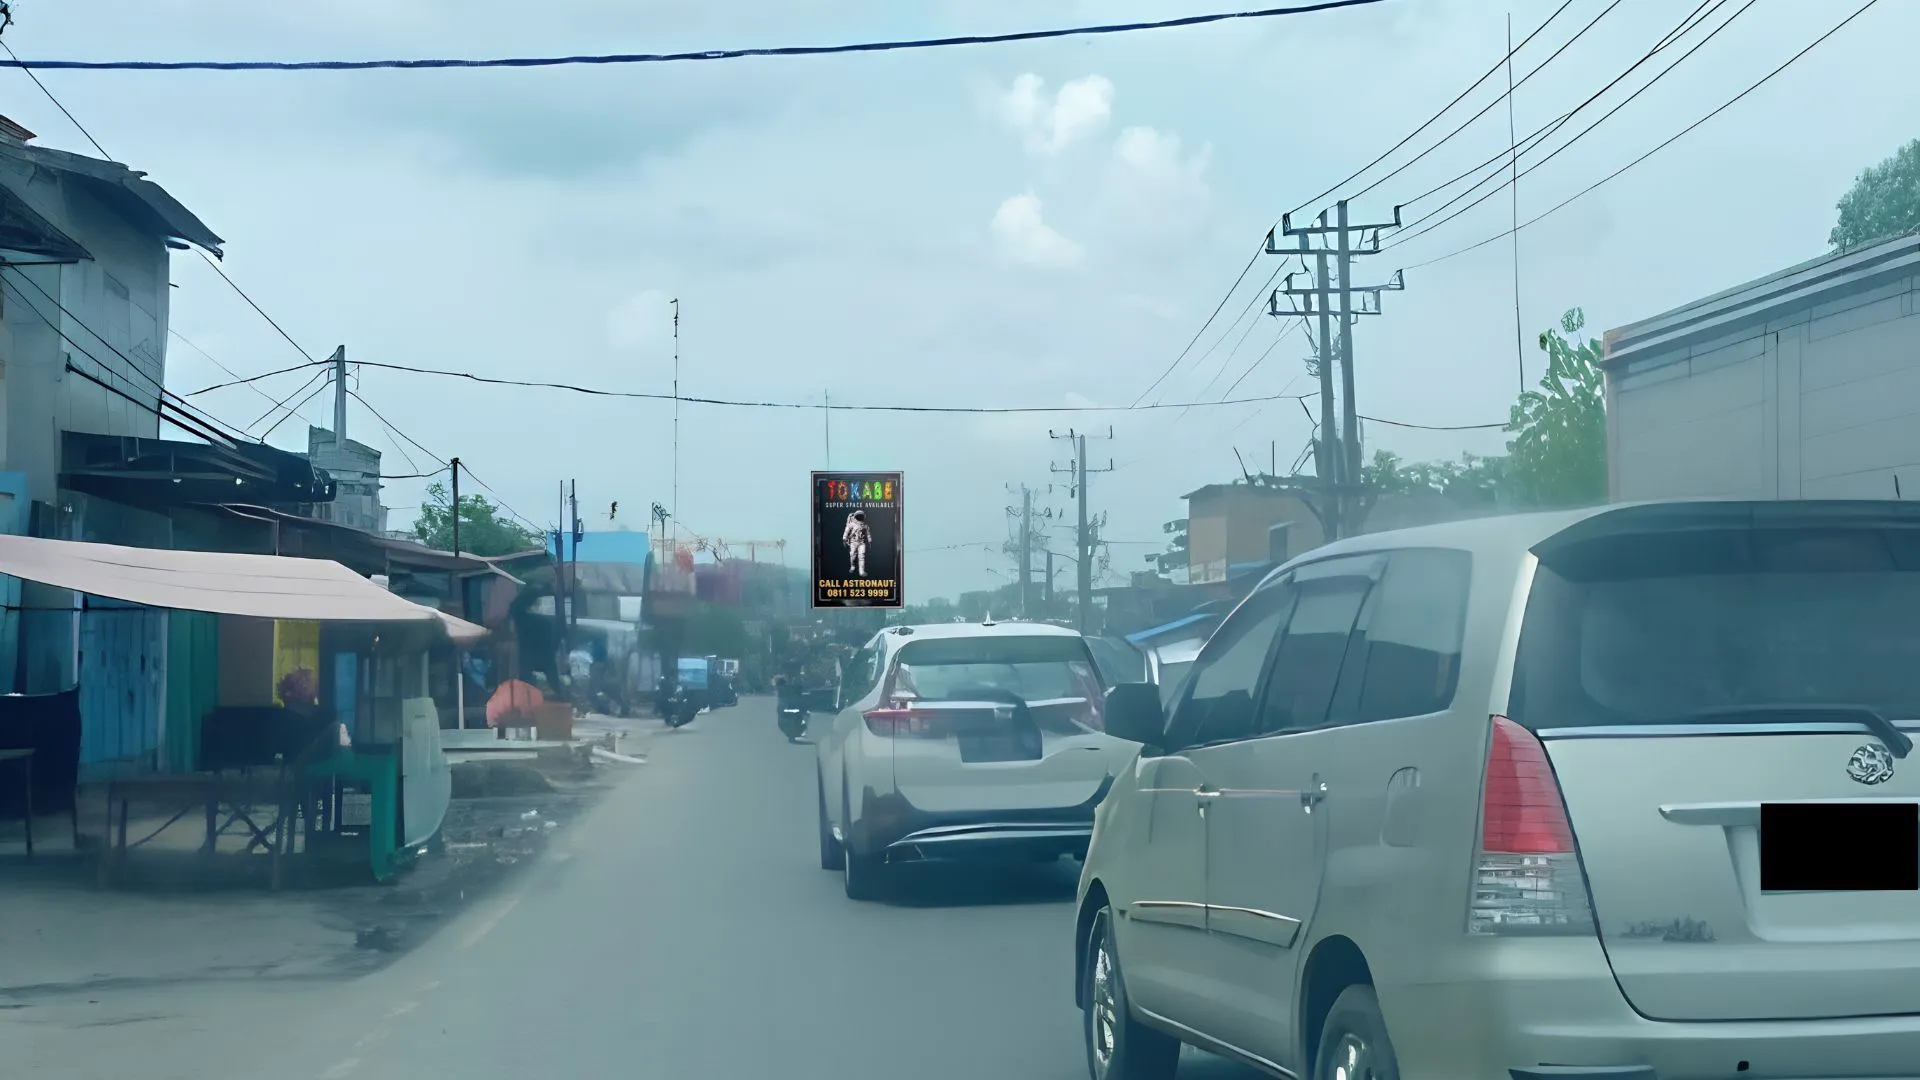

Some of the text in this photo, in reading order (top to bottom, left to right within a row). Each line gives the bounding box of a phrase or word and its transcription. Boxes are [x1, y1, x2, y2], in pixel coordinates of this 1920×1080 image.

[819, 579, 897, 588] CALL ASTRONAUT:
[827, 589, 888, 597] 0811 523 9999
